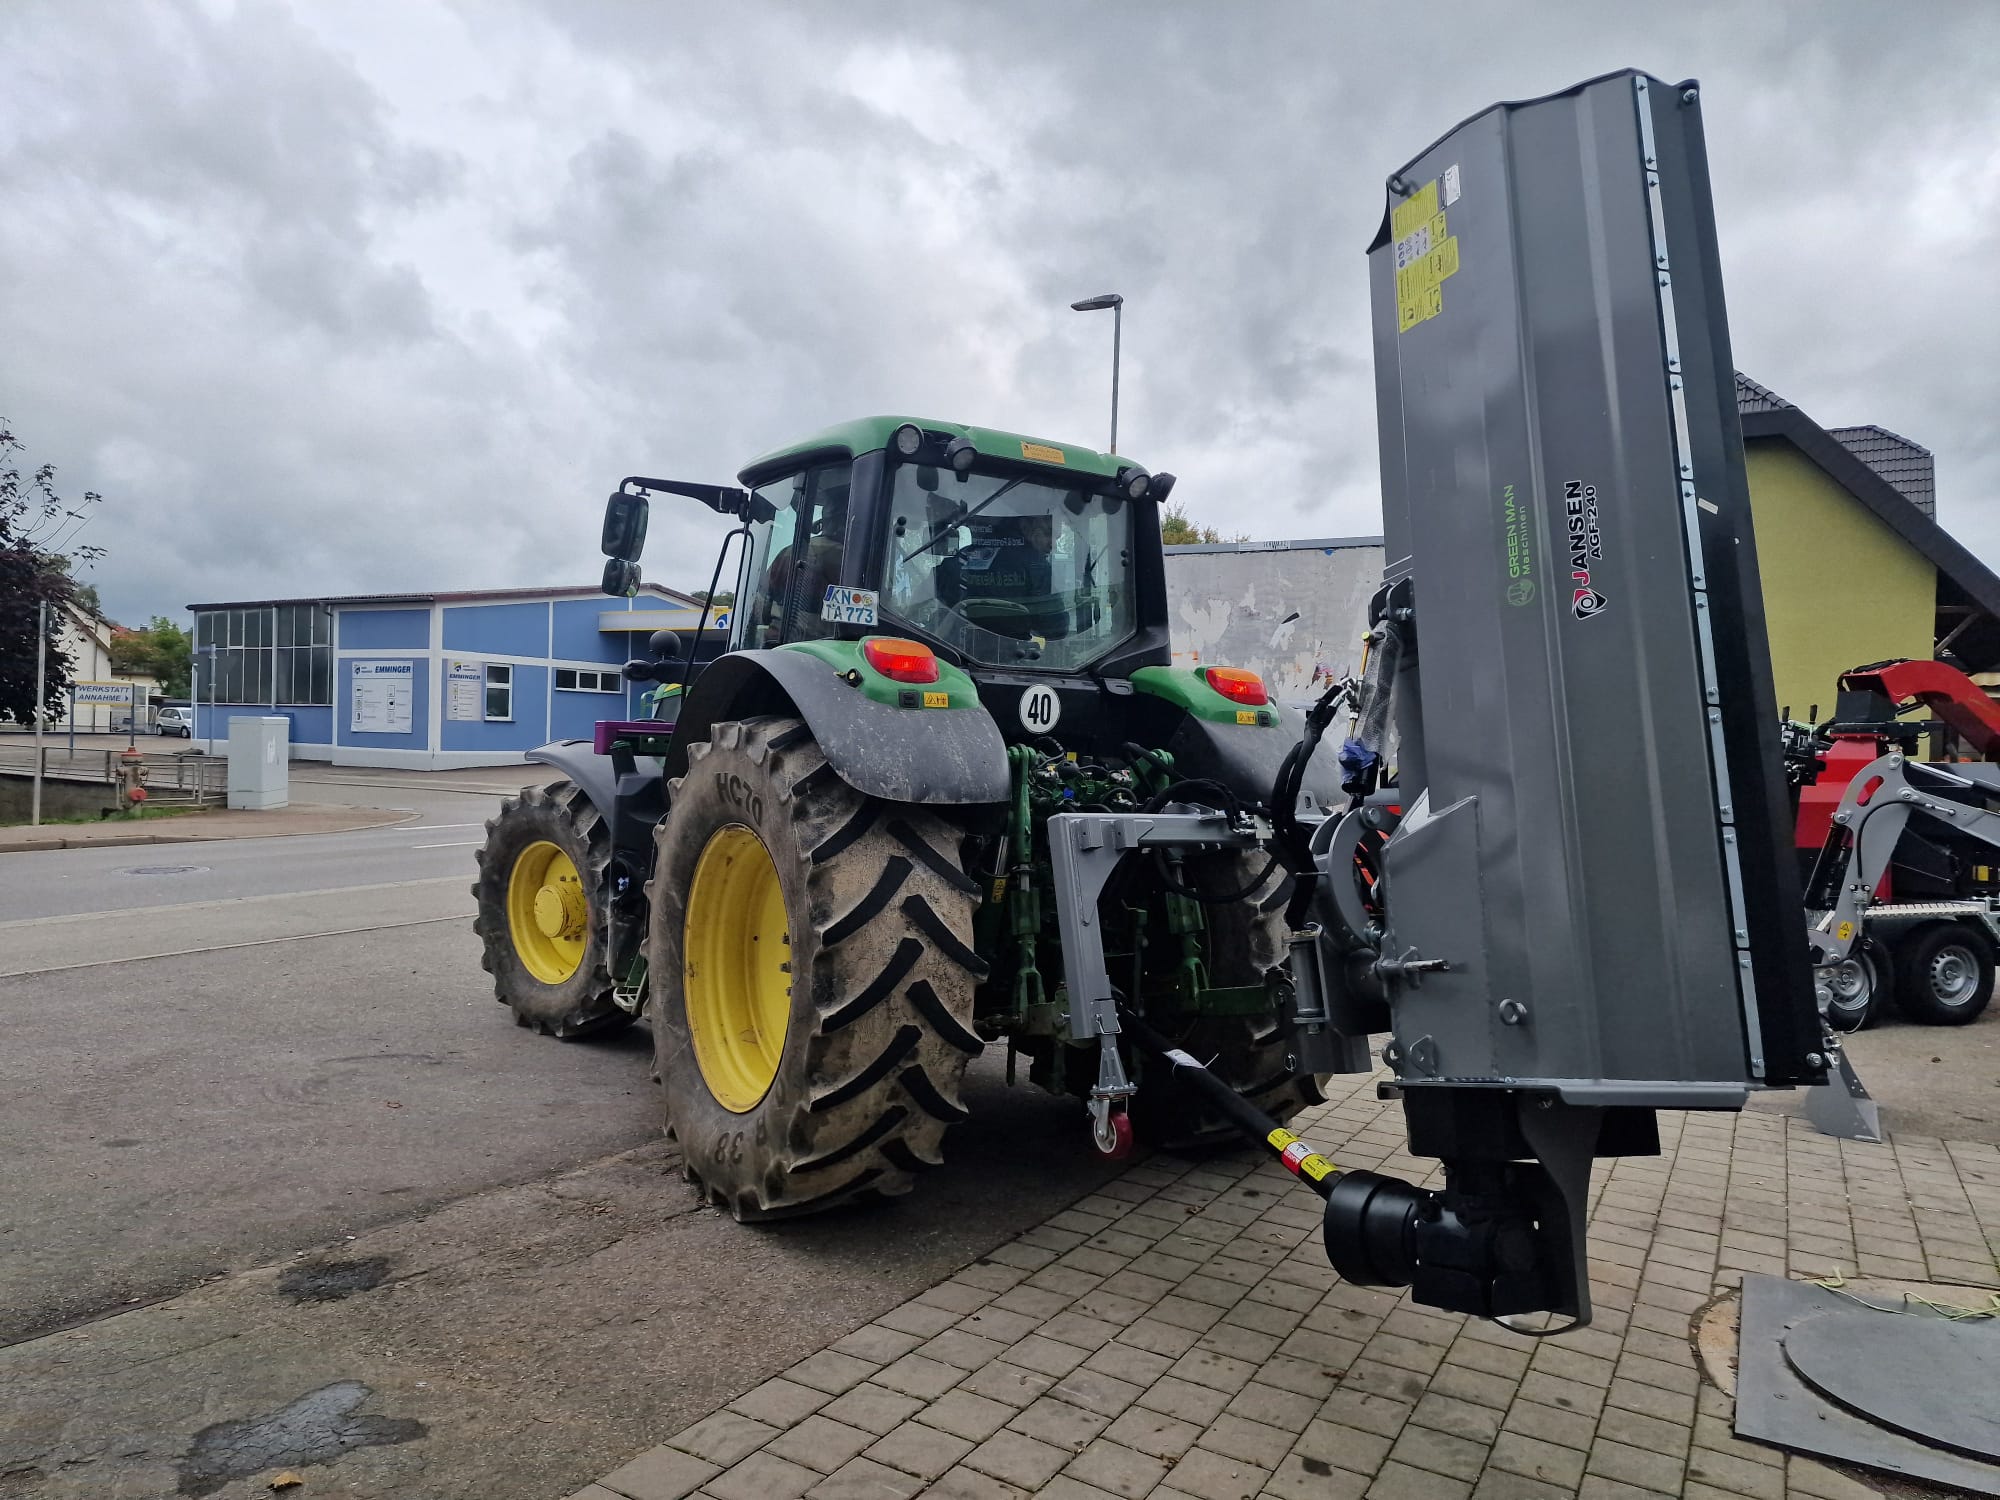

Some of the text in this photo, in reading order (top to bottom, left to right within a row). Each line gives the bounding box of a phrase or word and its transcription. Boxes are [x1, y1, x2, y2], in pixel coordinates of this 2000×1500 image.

[1504, 484, 1520, 578] GREEN MAN
[1519, 505, 1531, 575] Maschinen
[1564, 480, 1591, 586] JANSEN
[1585, 485, 1603, 560] AGF-240
[830, 589, 851, 604] KN
[846, 606, 873, 623] 773
[79, 685, 129, 693] WERKSTATT
[374, 665, 411, 673] EMMINGER
[1028, 694, 1051, 725] 40
[716, 772, 763, 826] HC70
